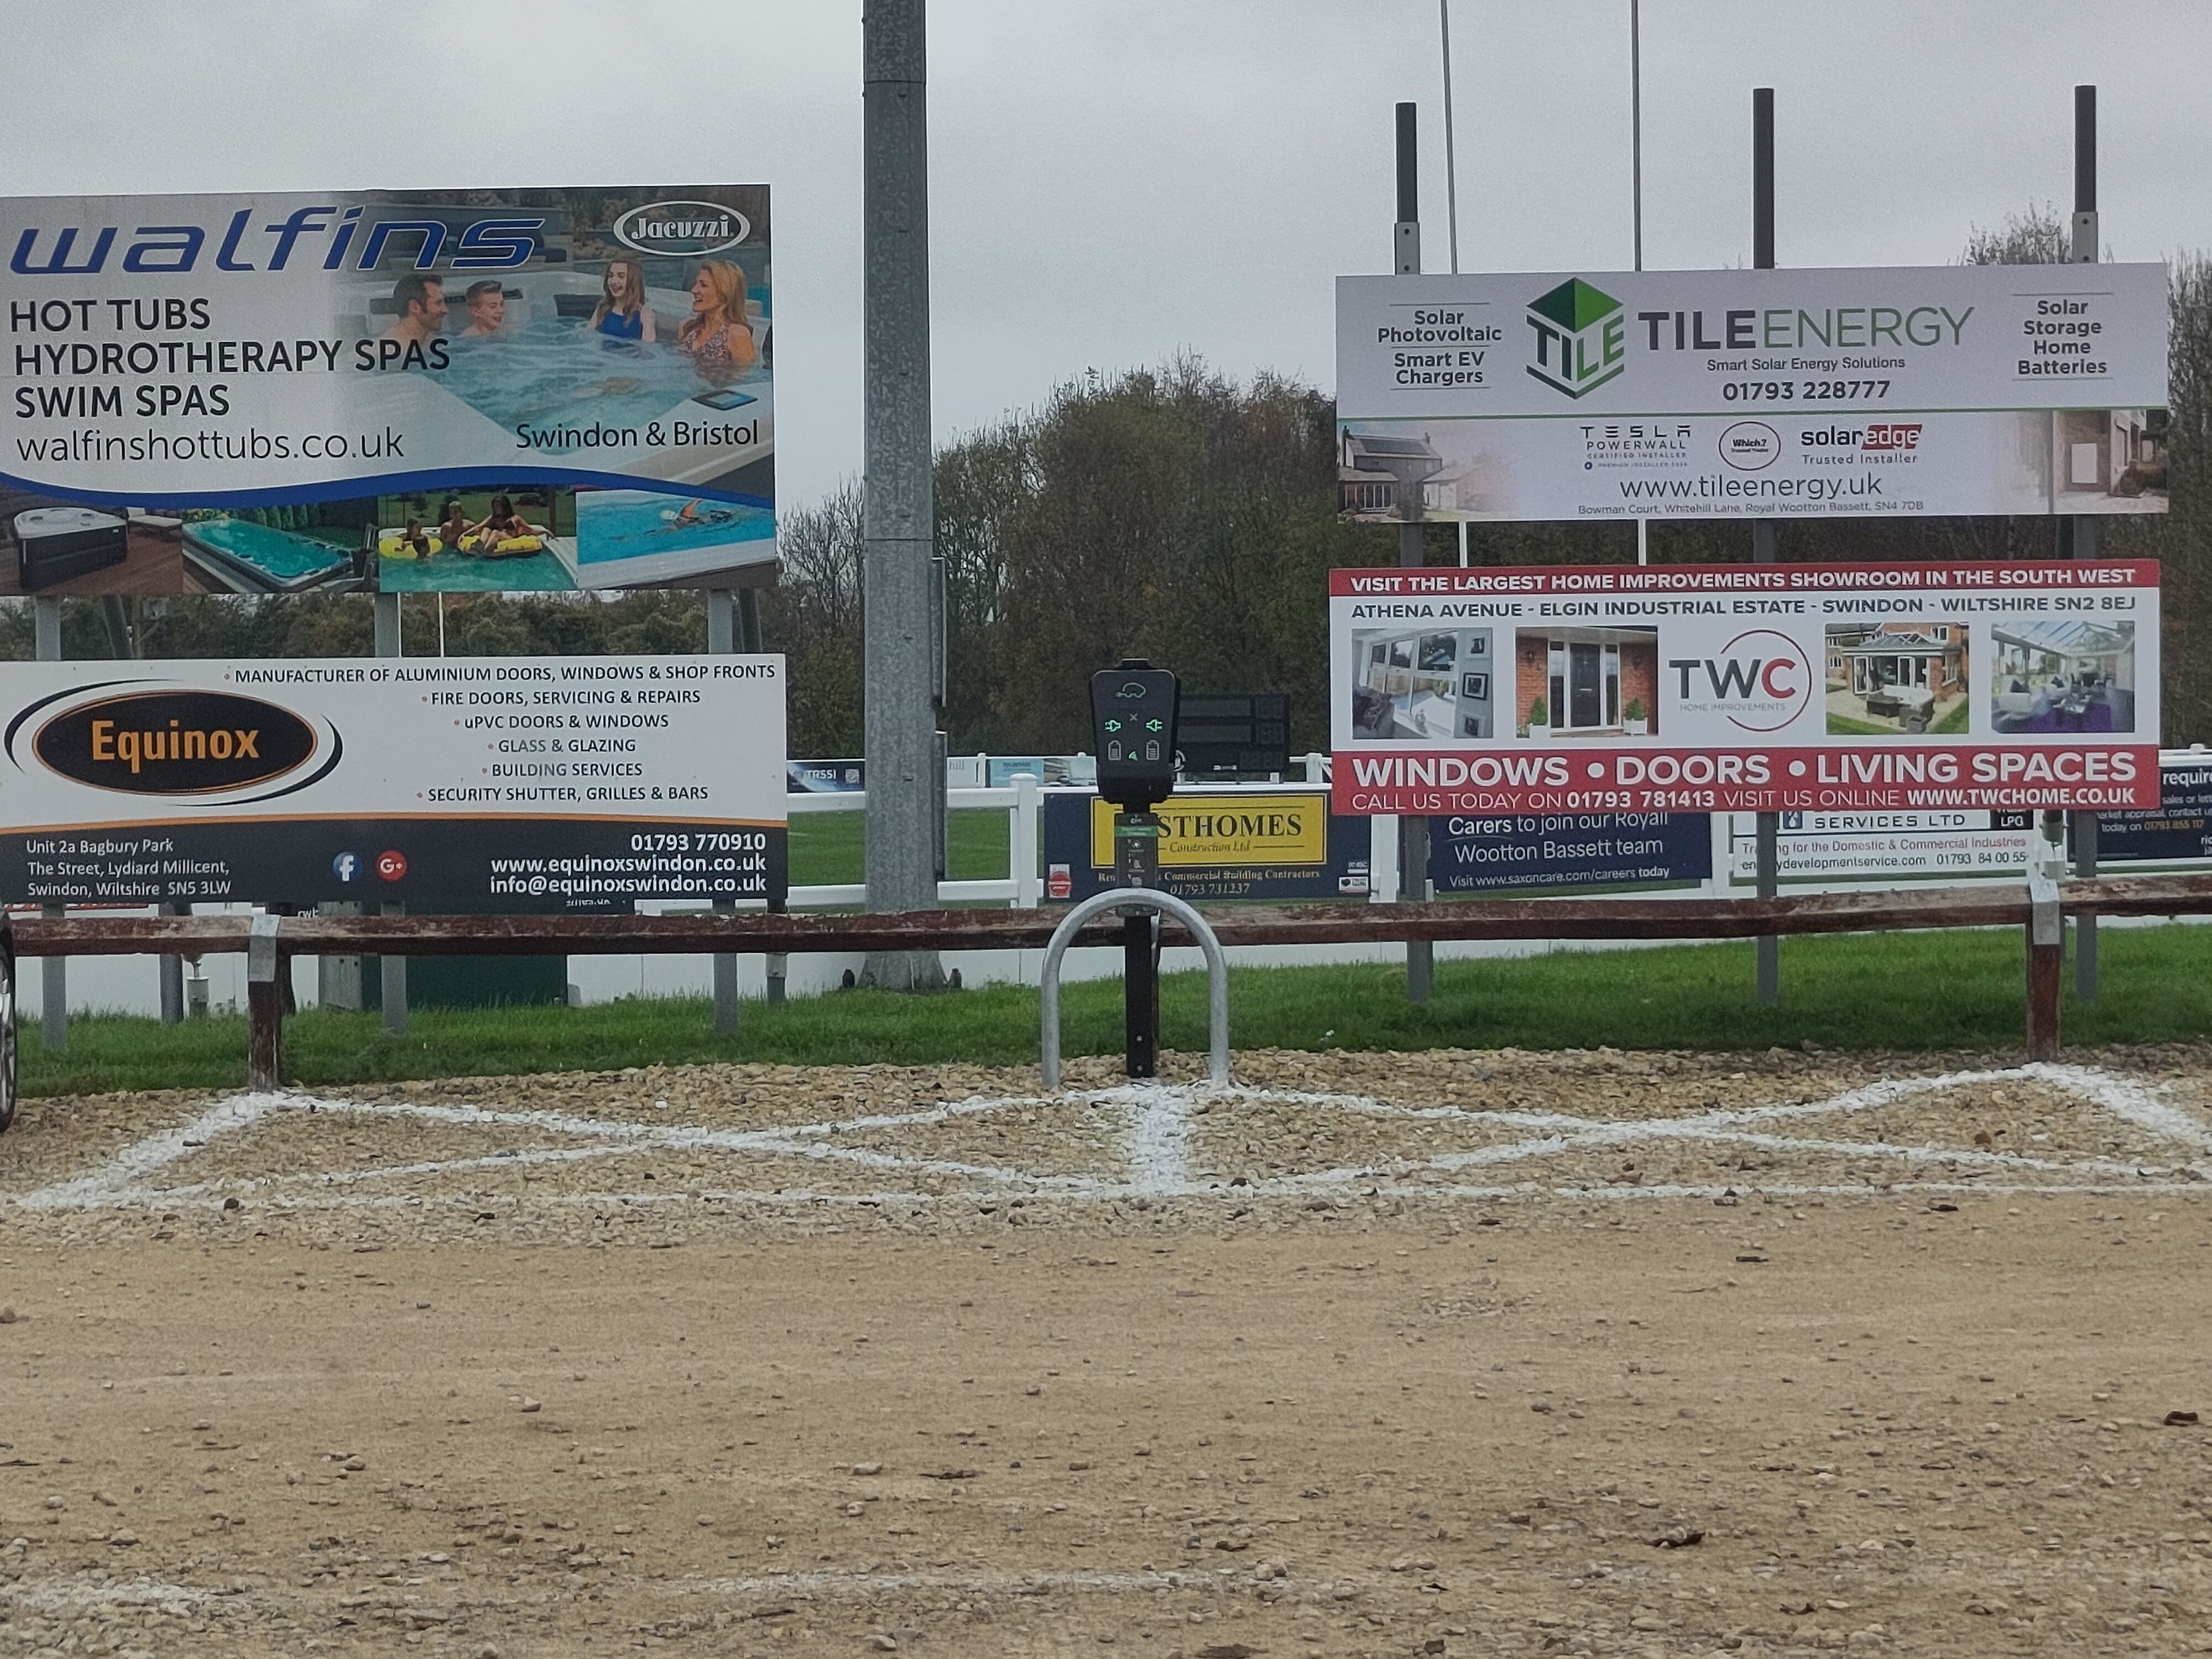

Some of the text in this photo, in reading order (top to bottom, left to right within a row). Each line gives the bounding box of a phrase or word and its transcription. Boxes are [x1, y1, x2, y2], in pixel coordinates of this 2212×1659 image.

[631, 215, 730, 239] Jacuzzi
[10, 206, 546, 274] walfins
[11, 298, 211, 332] HOT TUBS
[1414, 307, 1465, 325] Solar
[2037, 299, 2089, 316] Solar
[1377, 326, 1503, 343] Photovoltaic
[1637, 306, 1975, 351] TILEENERGY
[2023, 319, 2103, 337] Storage
[15, 338, 451, 375] HYDROTHERAPY SPAS
[1526, 313, 1625, 383] TILE
[2033, 339, 2092, 355] Home
[1394, 351, 1485, 368] Smart EV
[1707, 355, 1906, 373] Smart Solar Energy Solutions
[2017, 359, 2107, 375] Batteries
[1395, 368, 1484, 387] Chargers
[1723, 380, 1891, 401] 01793 228777
[15, 384, 230, 418] SWIM SPAS
[516, 419, 759, 449] Swindon & Bristol
[1579, 425, 1692, 439] TESLA
[1801, 425, 1921, 449] solaredge
[17, 426, 404, 461] walfinshottubs.co.uk
[1587, 440, 1686, 450] POWERWALL
[1802, 453, 1917, 465] Trusted Installer
[1620, 471, 1882, 499] www.tileenergy.uk
[1578, 501, 1897, 514] Bowman Royal Wootton SN4
[1350, 568, 2136, 592] VISIT THE LARGEST HOME IMPROVEMENTS SHOWROOM IN THE SOUTH WEST
[1351, 597, 2136, 618] ATHENA AVENUE ELGIN INDUSTRIAL ESTATE SWINDON WILTSHIRE SN2 8EJ
[235, 665, 775, 683] MANUFACTURER OF ALUMINIUM DOORS, WINDOWS & SHOP FRONTS
[1668, 658, 1797, 700] TWC
[431, 690, 701, 707] FIRE DOORS, SERVICING & REPAIRS
[1679, 702, 1786, 712] HOME IMPROVEMENTS
[465, 714, 669, 729] uPVC DOORS & WINDOWS
[92, 719, 259, 773] Equinox
[499, 738, 636, 753] GLASS & GLAZING
[492, 763, 643, 777] BUILDING SERVICES
[1352, 752, 2136, 787] WINDOWS DOORS LIVING SPACES
[427, 786, 709, 803] SECURITY SHUTTER, GRILLES & BARS
[1352, 787, 2135, 810] CALL US TODAY ON 01793 781413 VISIT US ONLINE WWW.TWCHOME.CO.UK
[1448, 816, 1512, 836] Carers
[1517, 817, 1535, 833] to
[1539, 813, 1573, 837] join
[1579, 815, 1609, 829] our
[1814, 814, 1965, 830] SERVICES LTD
[27, 838, 174, 855] Unit 2a Bagbury Park
[630, 833, 766, 852] 01793 770910
[1170, 840, 1251, 853] Construction Ltd
[1454, 838, 1663, 864] Wootton Bassett team
[1793, 841, 1808, 853] for
[1812, 841, 1829, 852] the
[1833, 839, 1885, 852] Domestic
[1889, 840, 1897, 851] &
[1901, 837, 1968, 851] Commercial
[1971, 836, 2026, 848] Industries
[491, 853, 766, 877] www.equinoxswindon.co.uk
[1937, 851, 2026, 864] 01793 84 00 55
[28, 859, 230, 878] The Street, Lydiard Millicent,
[1265, 869, 1321, 879] Contractors
[1449, 866, 1670, 888] Visit www.saxoncare.com/careers today
[28, 880, 232, 899] Swindon, Wiltshire SN5 3LW
[490, 873, 766, 896] info@equinoxswindon.co.uk
[1170, 884, 1205, 895] 01793
